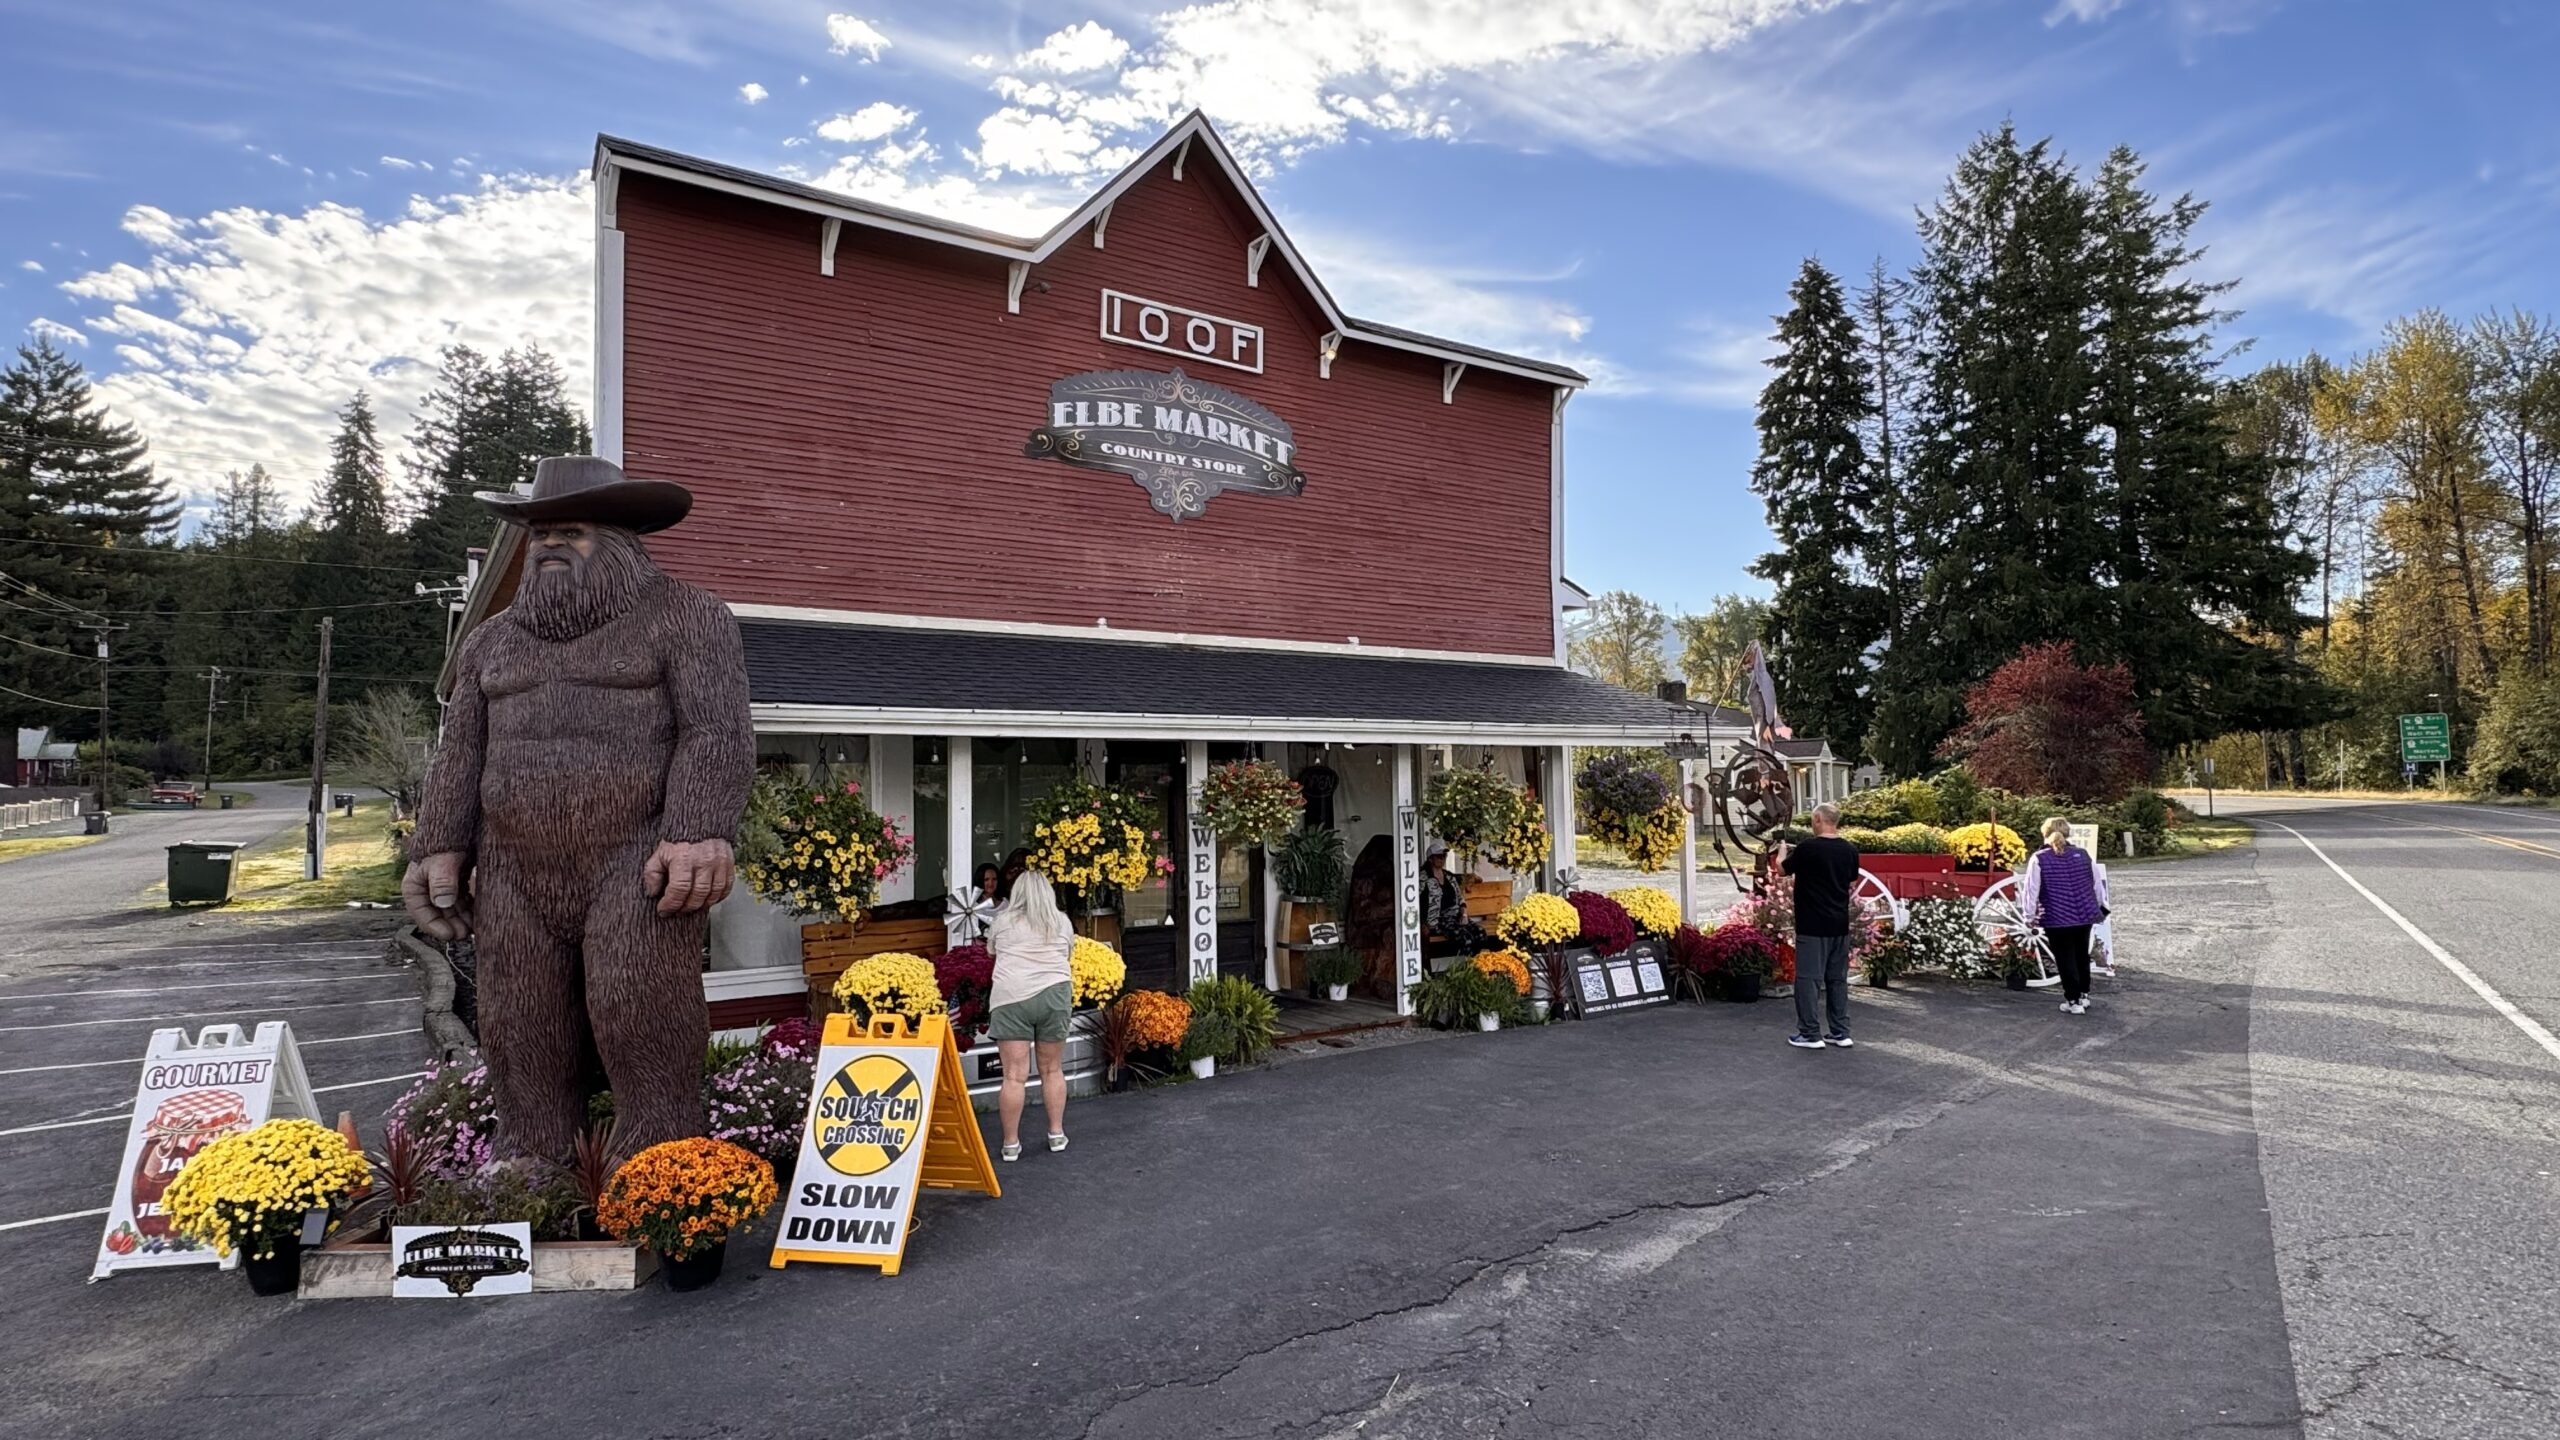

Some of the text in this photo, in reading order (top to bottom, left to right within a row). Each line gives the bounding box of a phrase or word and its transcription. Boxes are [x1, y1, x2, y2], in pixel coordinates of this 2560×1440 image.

[1113, 297, 1256, 361] IOOF
[1051, 401, 1296, 467] ELBE MARKET
[1100, 442, 1187, 466] COUNTRY
[1191, 457, 1247, 476] STORE
[1191, 828, 1215, 979] WELCOM
[145, 1059, 272, 1090] GOURMET
[823, 1126, 906, 1145] CROSSING
[800, 1183, 901, 1210] SLOW
[786, 1216, 896, 1245] DOWN
[405, 1244, 521, 1264] ELBE MARKET
